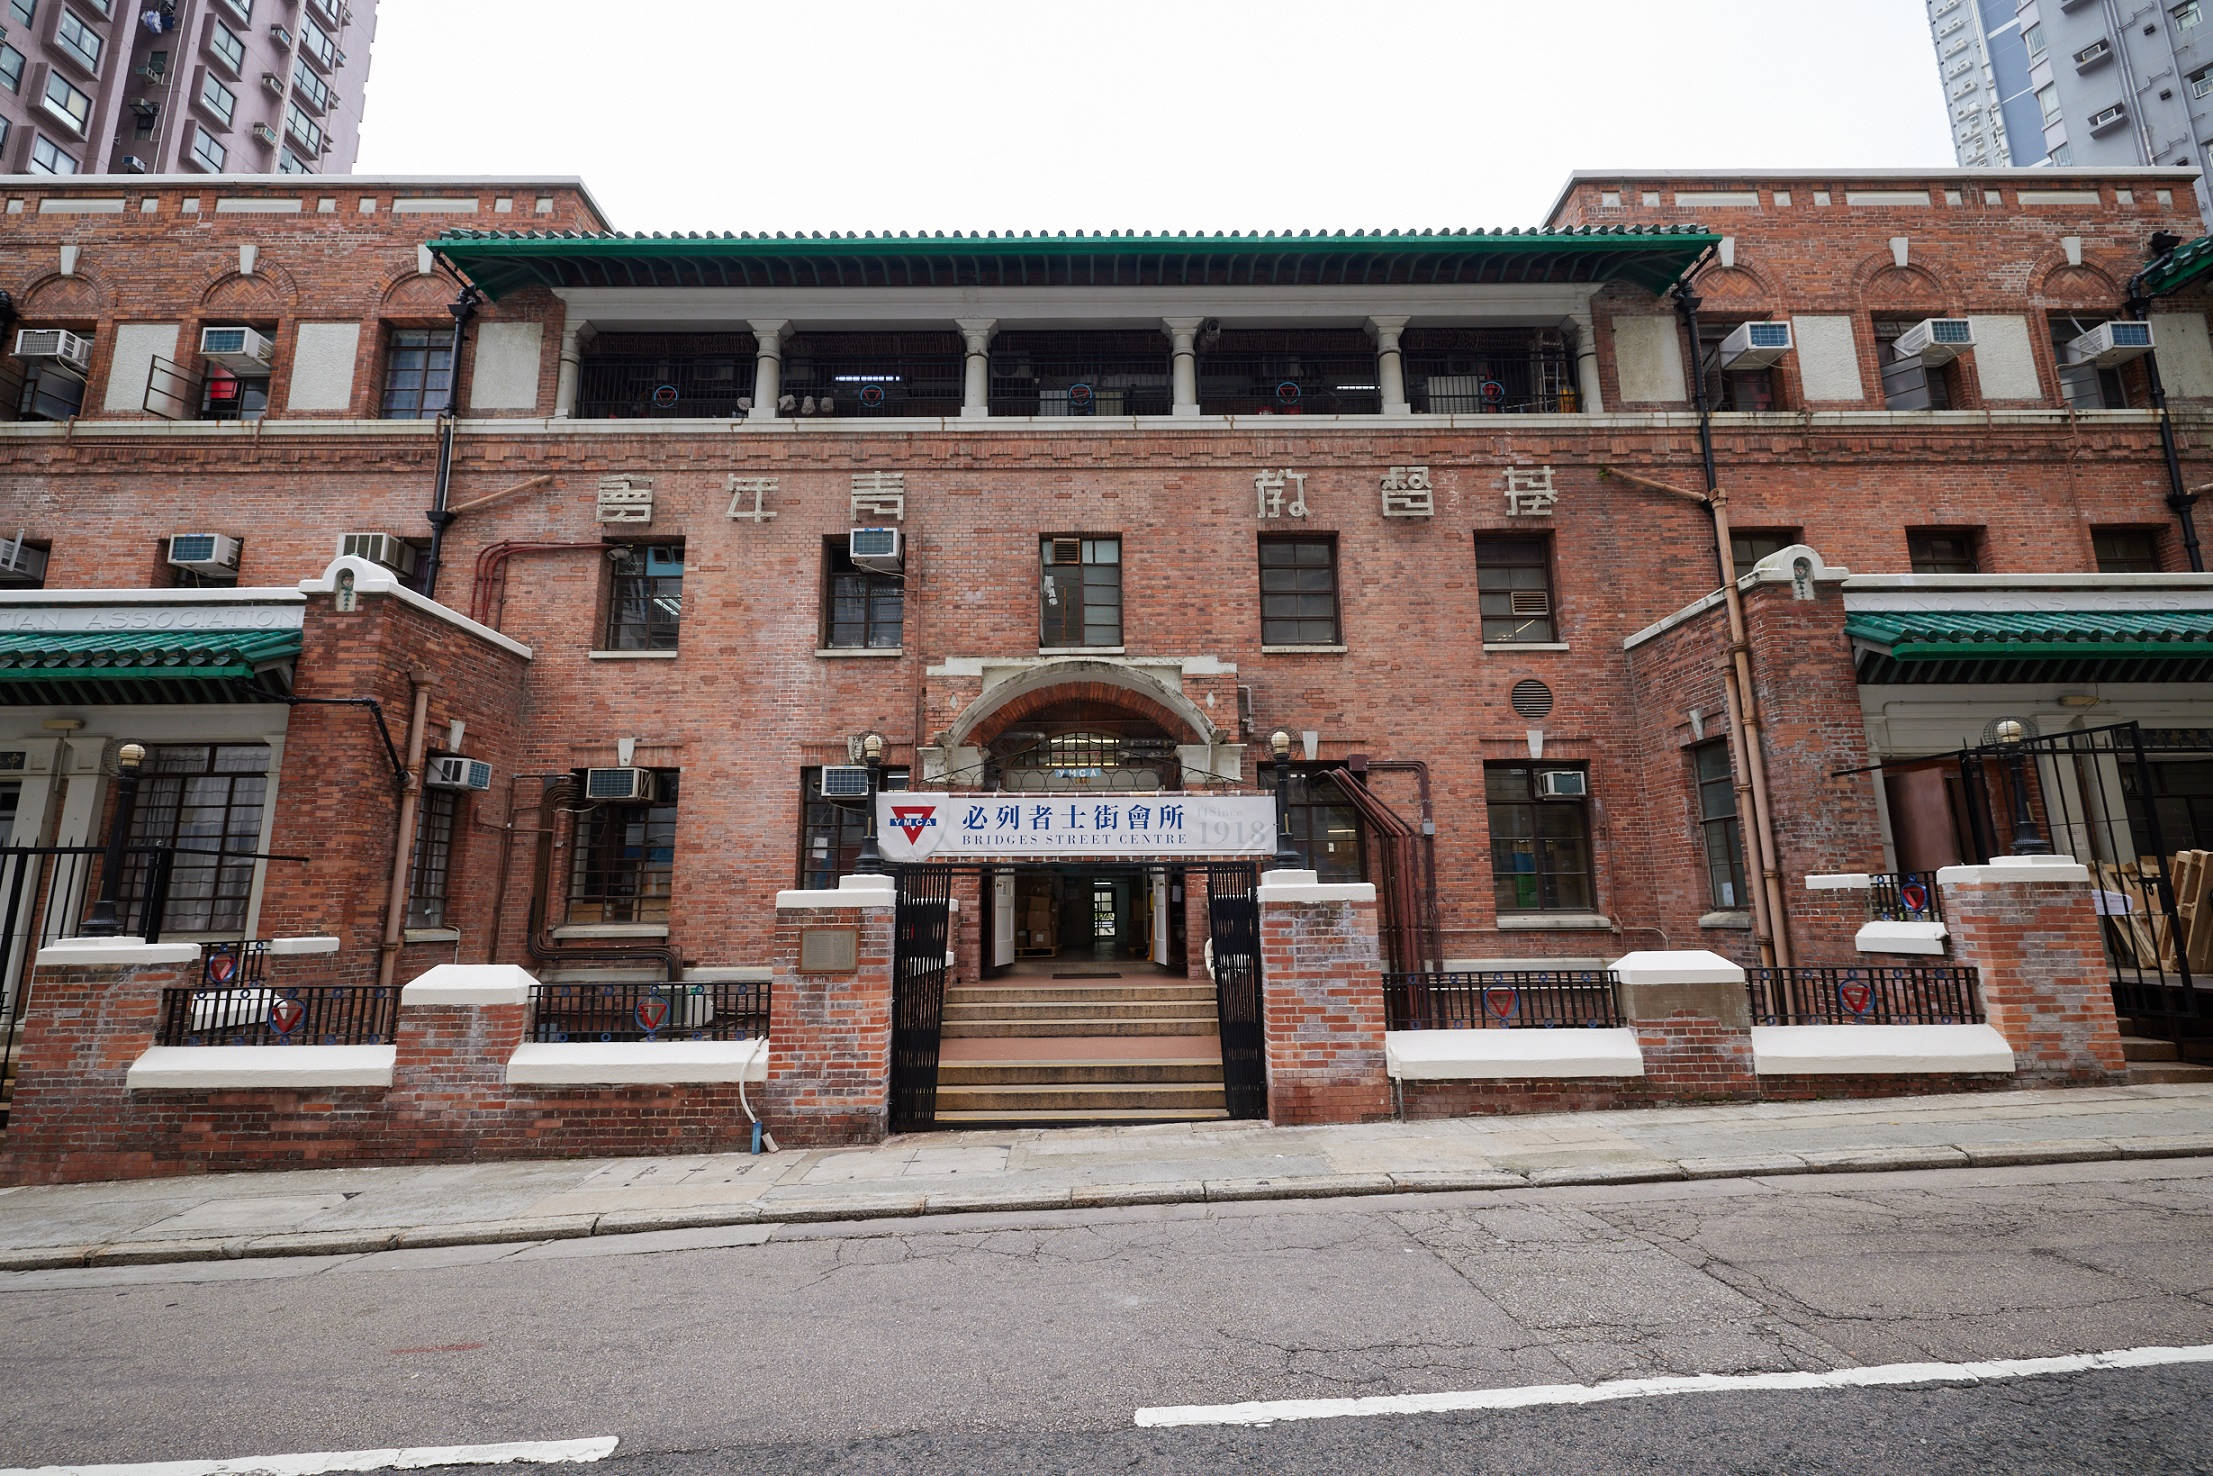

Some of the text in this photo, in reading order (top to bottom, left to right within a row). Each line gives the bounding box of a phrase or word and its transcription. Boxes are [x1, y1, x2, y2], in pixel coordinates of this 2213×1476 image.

[85, 610, 301, 629] ASSOCIATION
[1057, 769, 1097, 778] YMCA
[894, 818, 932, 827] YMCA
[963, 804, 1185, 830] 必列者士街會所
[962, 834, 1187, 845] BRIDGES STREET CENTRE
[1199, 819, 1266, 845] 1918
